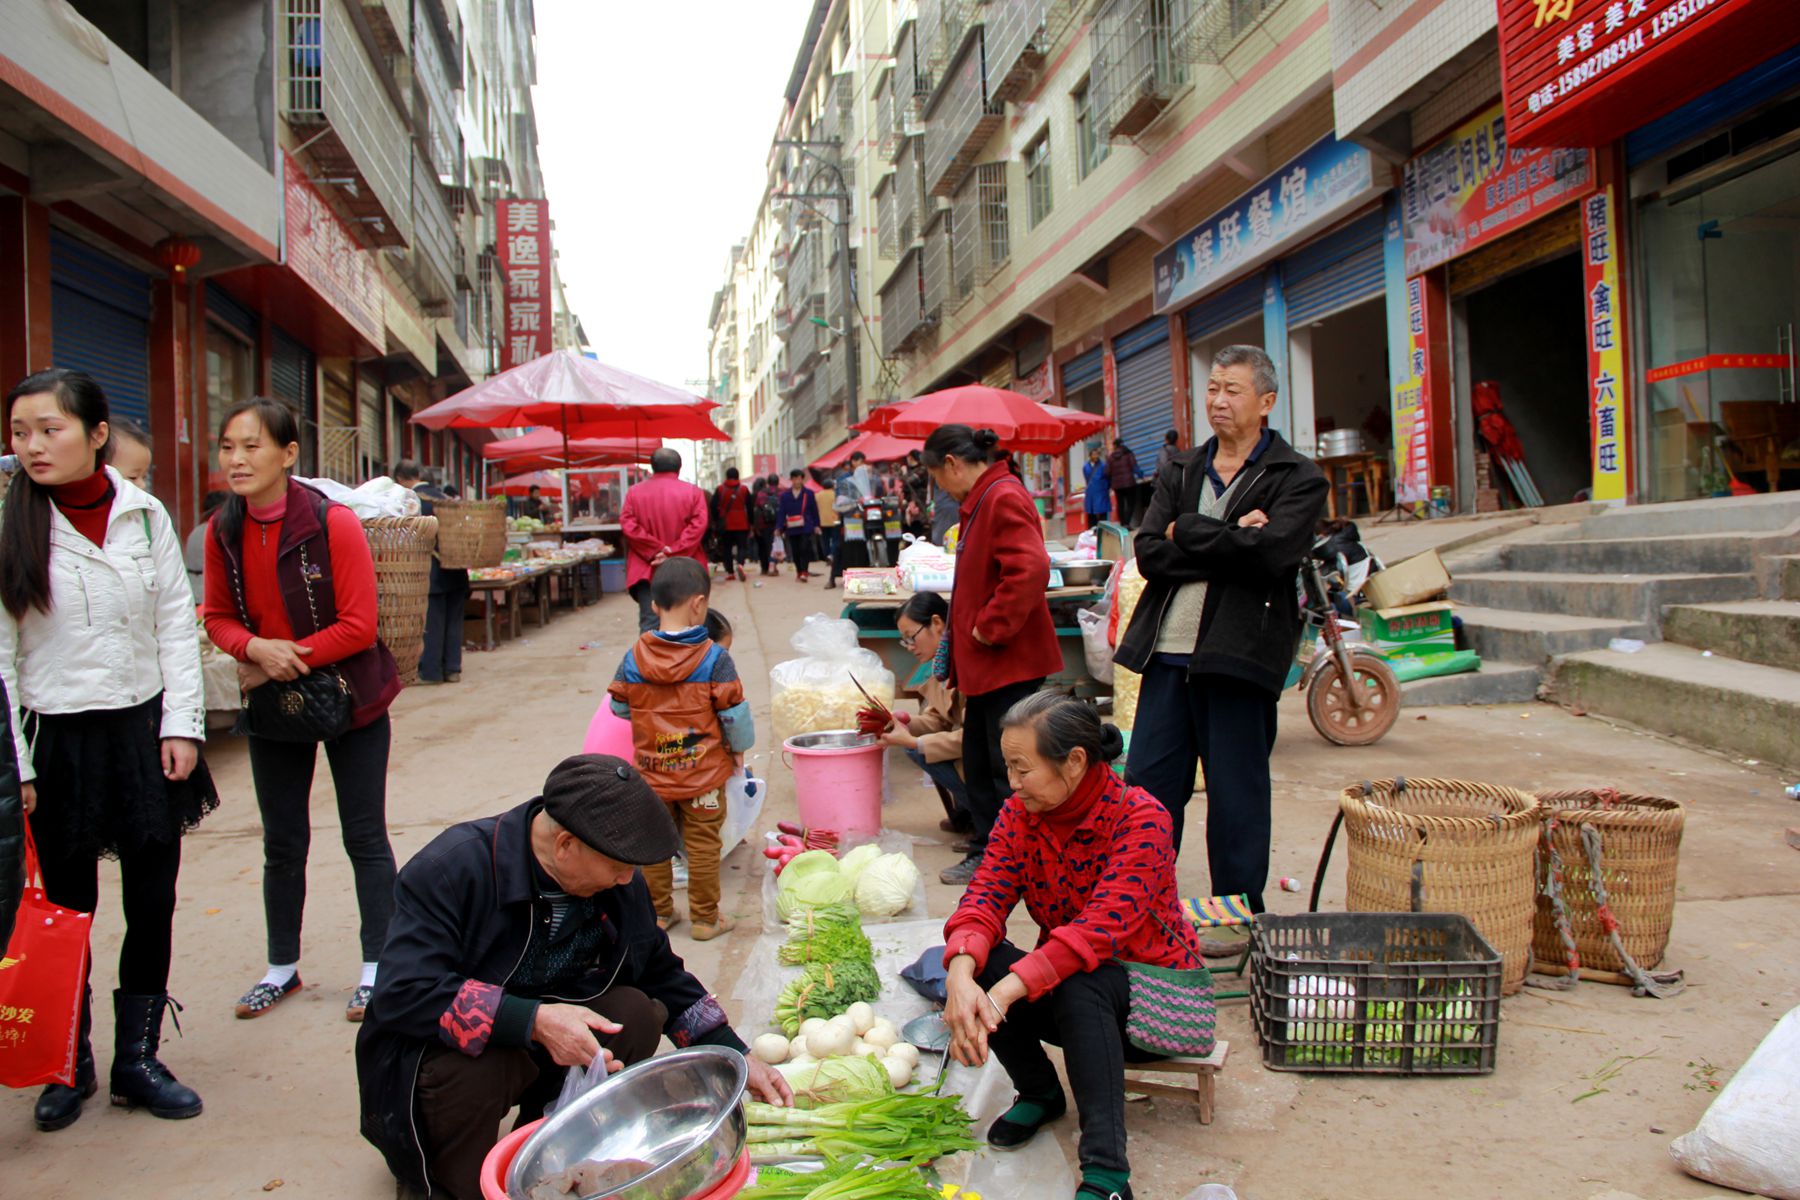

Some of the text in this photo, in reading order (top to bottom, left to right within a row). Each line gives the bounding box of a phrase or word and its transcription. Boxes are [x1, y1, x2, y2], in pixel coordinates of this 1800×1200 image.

[1557, 21, 1595, 66] 美容
[507, 202, 540, 366] 美逸家家私
[1191, 166, 1308, 279] 辉跃餐馆
[1587, 194, 1619, 474] 猪旺 禽旺 六畜旺
